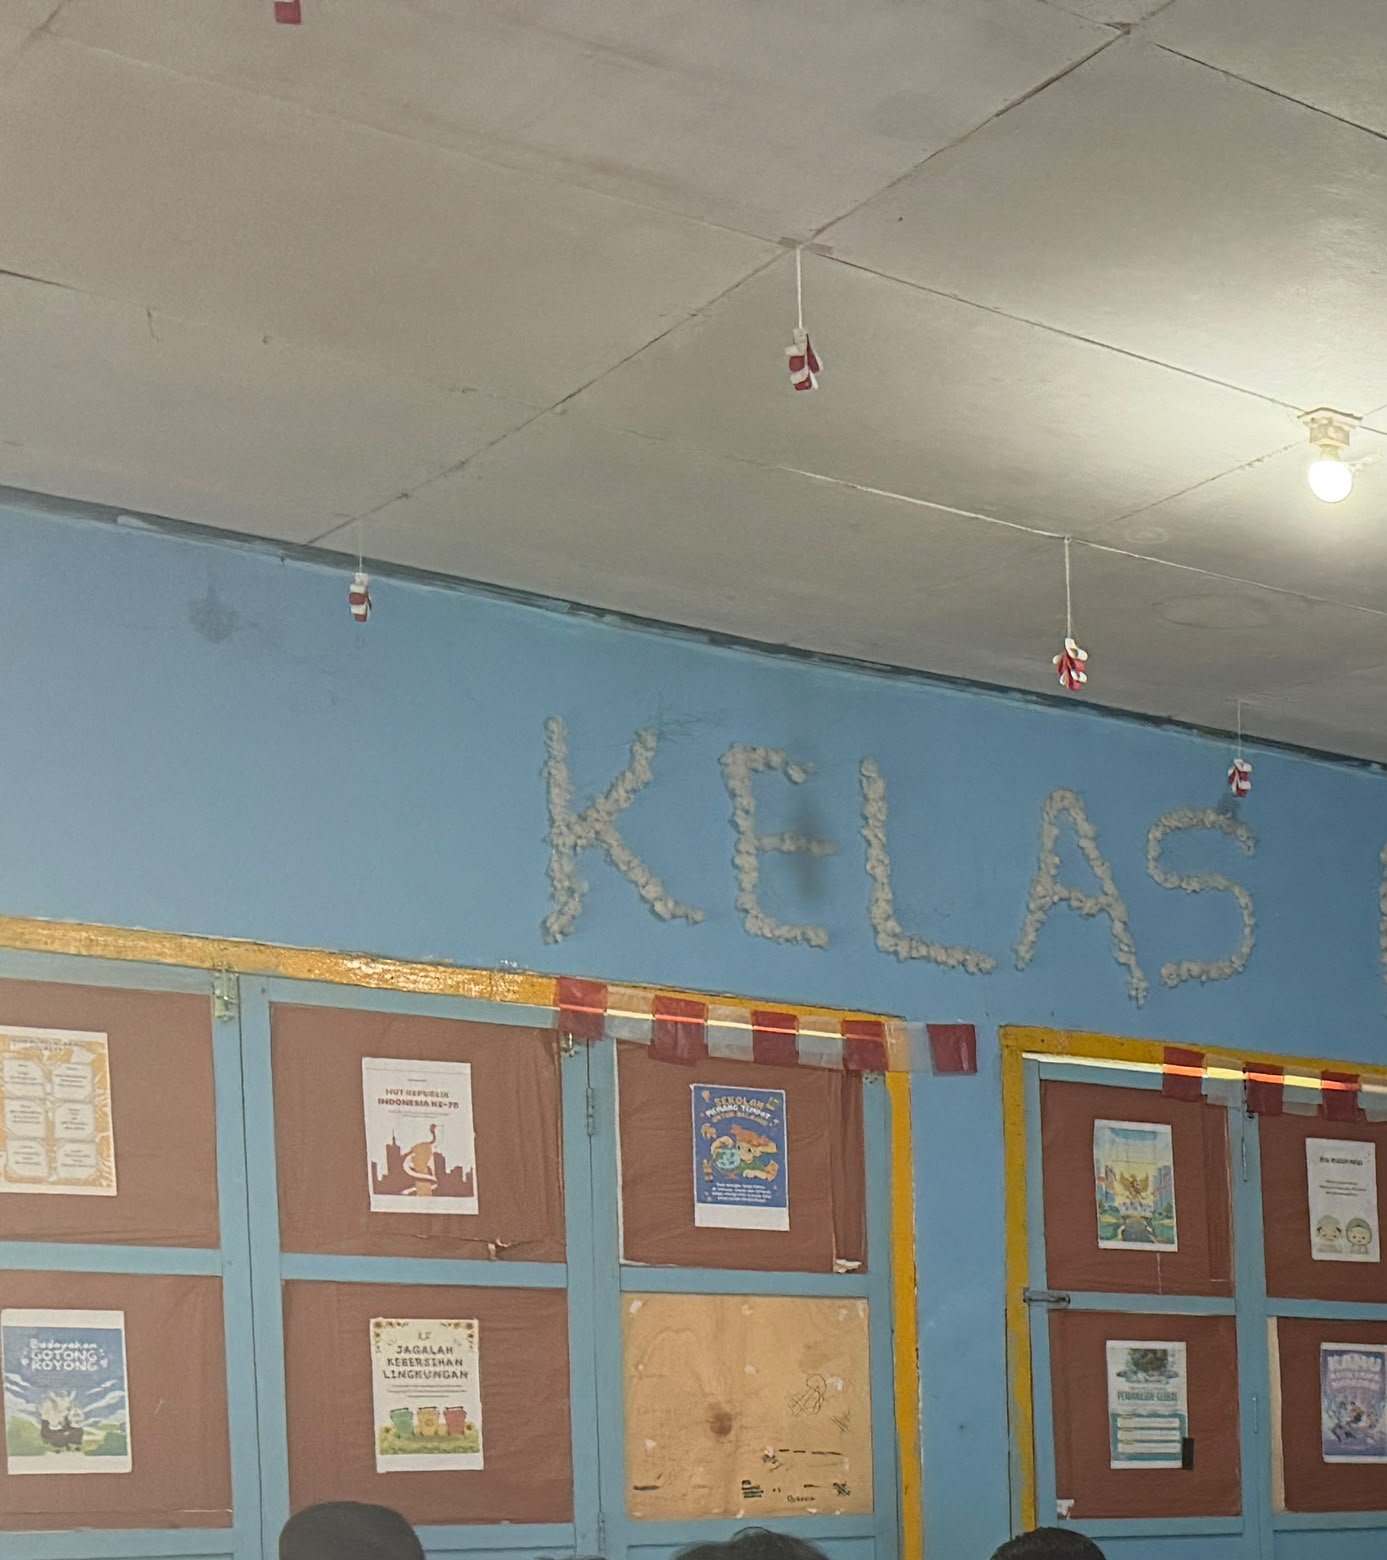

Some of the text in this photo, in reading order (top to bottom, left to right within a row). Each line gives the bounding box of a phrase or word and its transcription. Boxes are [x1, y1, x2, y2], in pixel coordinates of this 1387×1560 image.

[542, 714, 1256, 1007] KELAS
[378, 1097, 430, 1108] INDONESIA
[31, 1350, 97, 1361] GOTONG
[396, 1345, 454, 1355] JAGALAH
[31, 1360, 97, 1371] ROYONG
[387, 1357, 463, 1367] KEBERSIHAN
[383, 1369, 468, 1379] LINGKUNGAN
